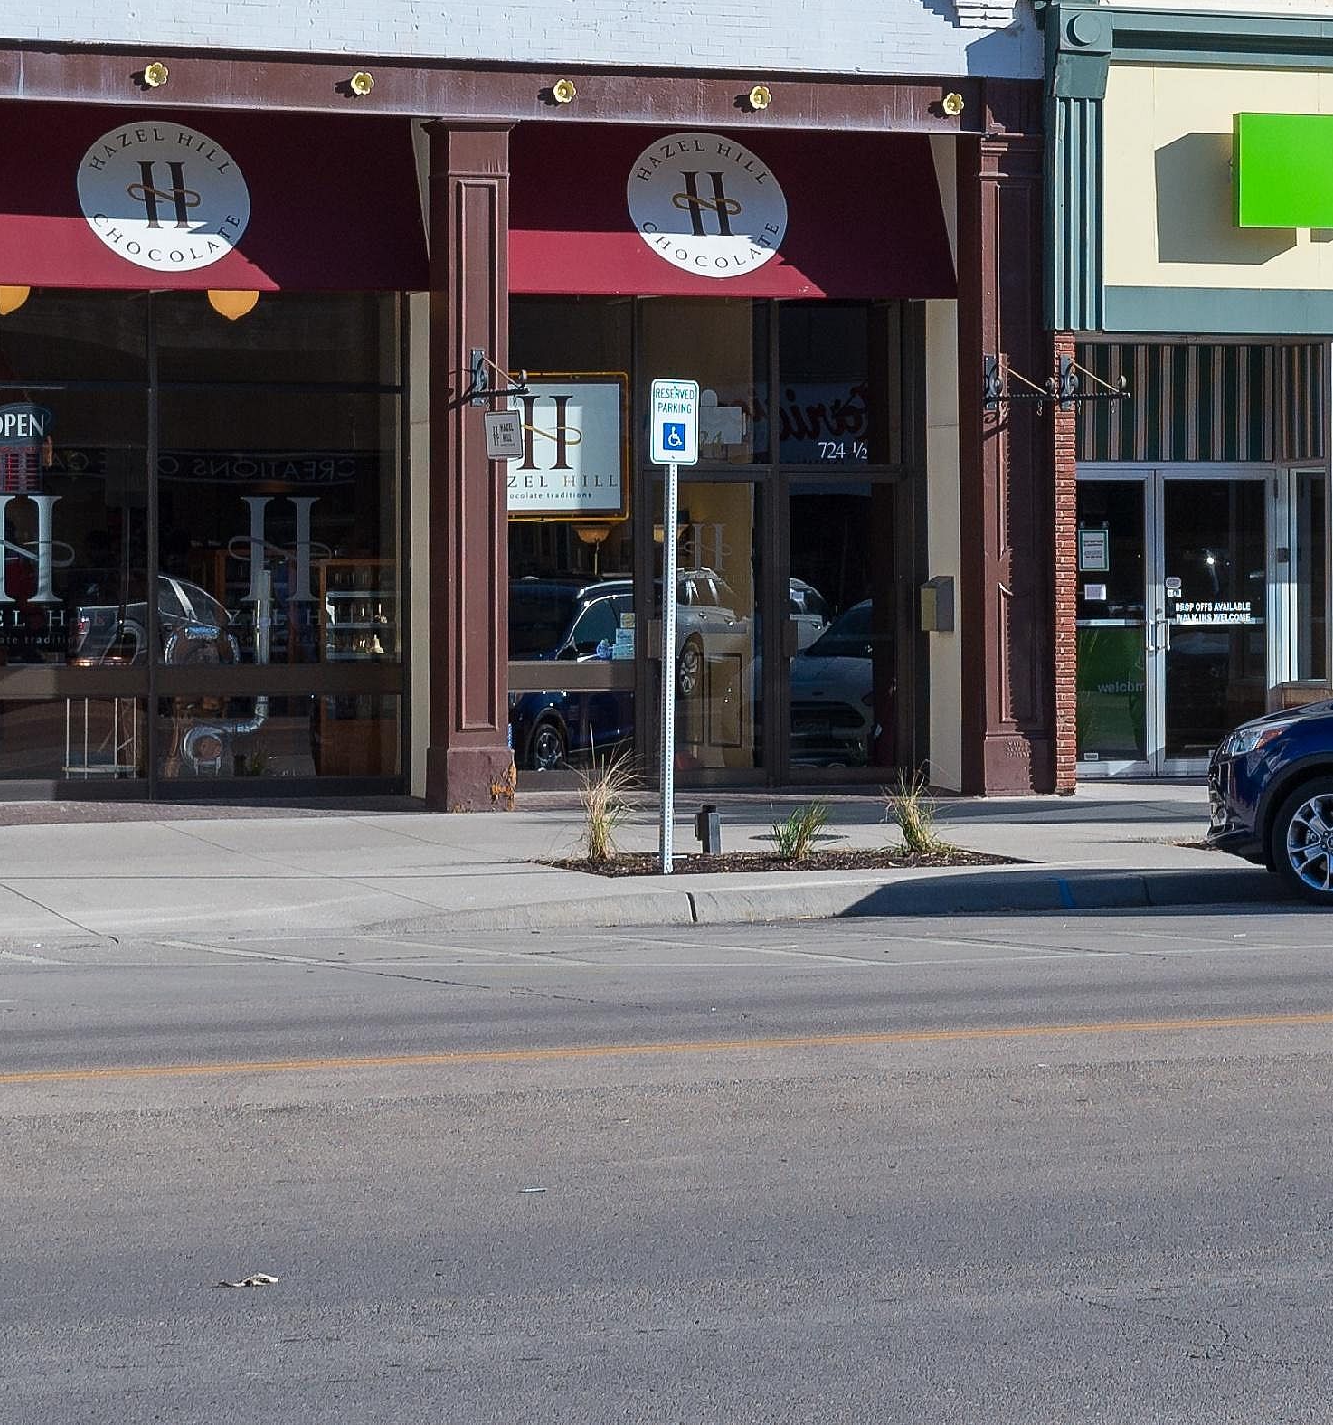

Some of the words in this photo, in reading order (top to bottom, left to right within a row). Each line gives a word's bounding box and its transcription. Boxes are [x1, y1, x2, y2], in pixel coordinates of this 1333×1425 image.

[89, 127, 165, 172] HAZEL
[177, 132, 233, 175] HILL
[636, 139, 706, 182] HAZEL
[717, 142, 769, 185] HILL
[93, 213, 241, 263] CHOCOLATE
[642, 221, 780, 269] CHOCOLATE
[655, 388, 695, 400] RESERVED
[657, 402, 692, 414] PARKING
[818, 441, 847, 460] 724
[507, 475, 549, 488] ZEL
[563, 474, 618, 488] HILL
[510, 492, 543, 500] ocolate
[546, 492, 592, 500] traditions
[1214, 601, 1251, 611] AVAILABLE
[1098, 681, 1146, 693] welcom
